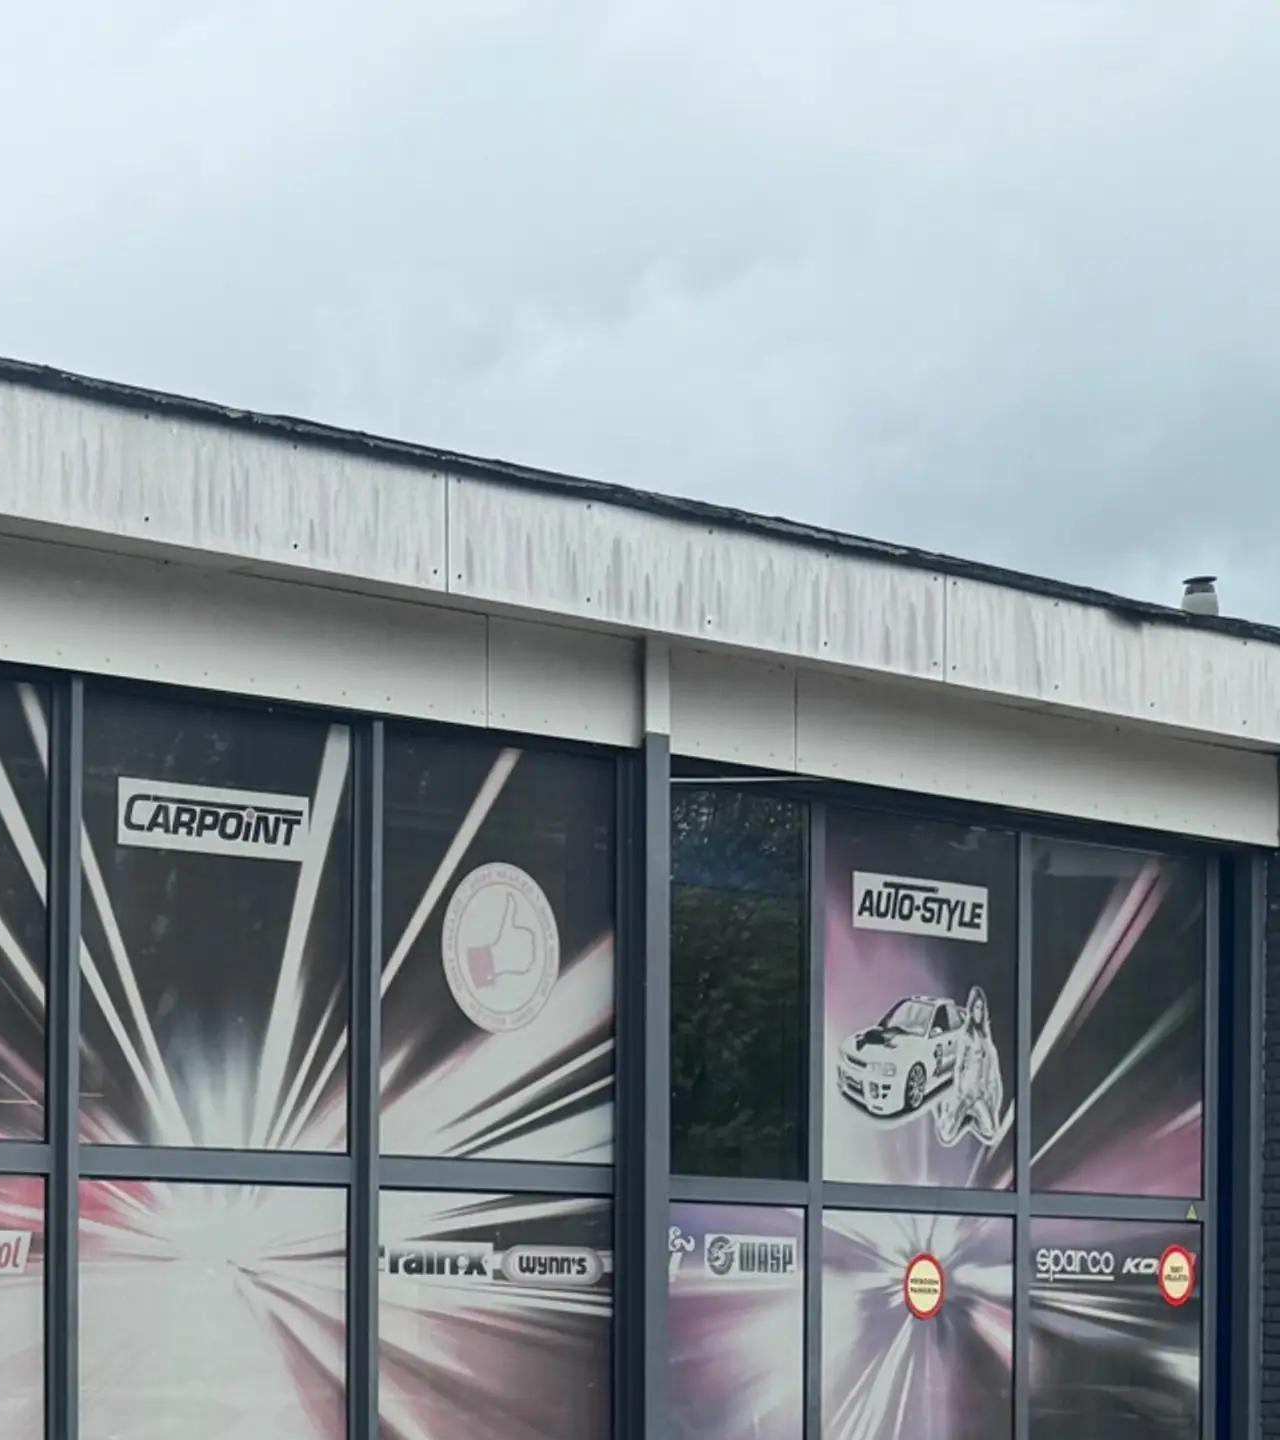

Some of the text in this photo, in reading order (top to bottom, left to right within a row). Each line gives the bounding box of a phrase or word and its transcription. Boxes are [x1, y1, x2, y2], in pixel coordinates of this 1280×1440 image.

[858, 881, 984, 932] AUTO-STYLE
[739, 1241, 793, 1274] WASP
[1035, 1247, 1115, 1282] sparco
[1122, 1256, 1162, 1276] KO
